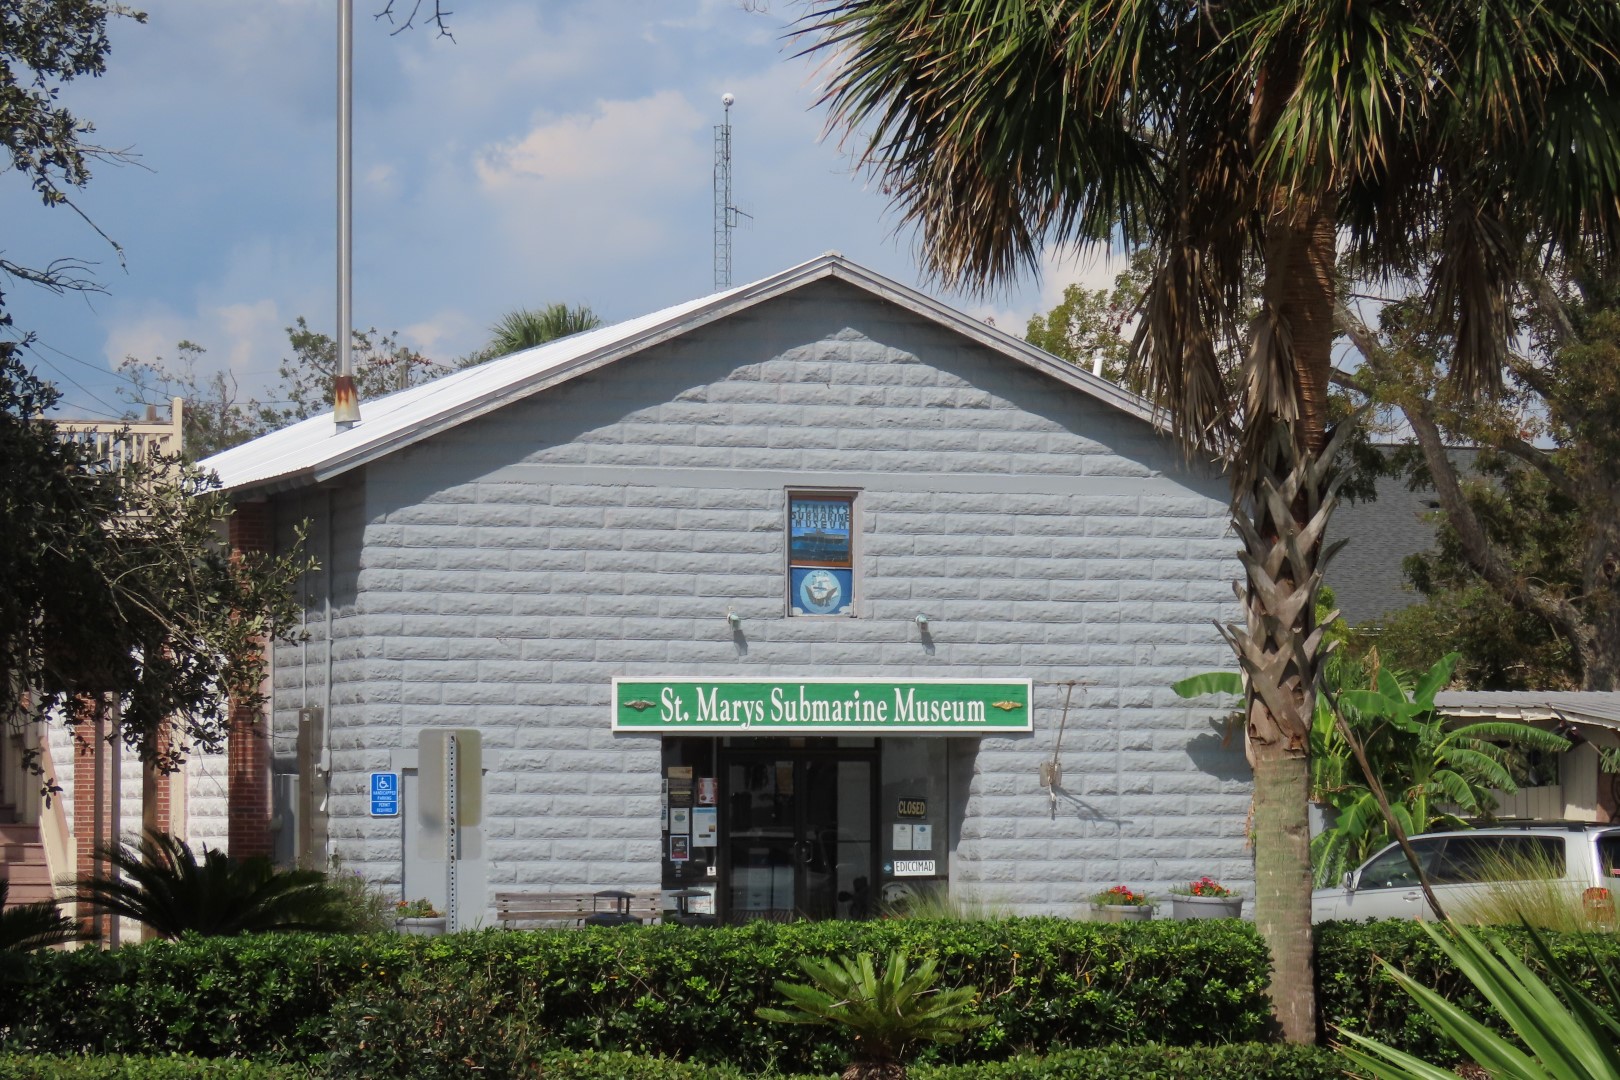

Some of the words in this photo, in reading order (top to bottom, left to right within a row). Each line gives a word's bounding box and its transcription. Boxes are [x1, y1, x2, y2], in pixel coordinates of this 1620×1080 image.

[791, 511, 850, 522] SUBMARINE
[795, 519, 847, 530] MUSEUM
[661, 687, 690, 722] St.
[696, 687, 765, 729] Marys
[771, 685, 888, 722] Submarine
[894, 687, 986, 722] Museum
[898, 801, 926, 815] CLOSED
[895, 861, 934, 872] EDICCIMAD
